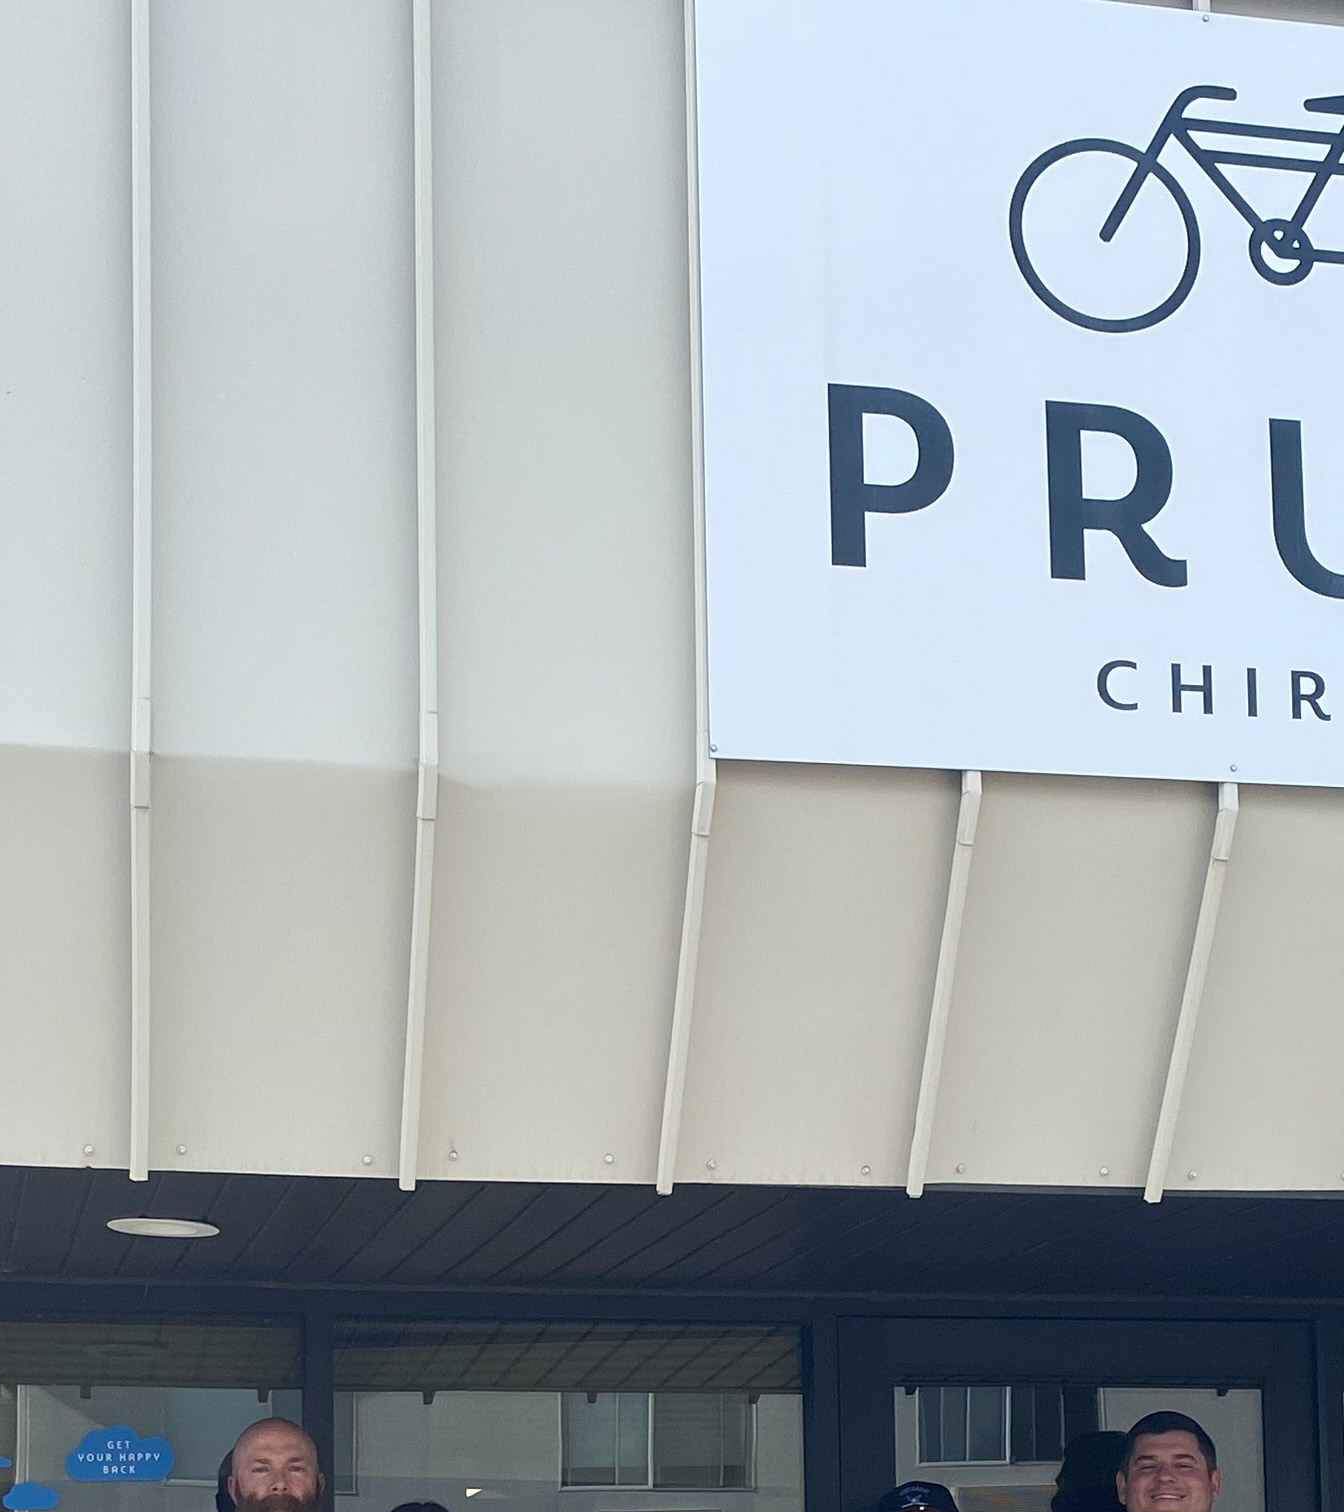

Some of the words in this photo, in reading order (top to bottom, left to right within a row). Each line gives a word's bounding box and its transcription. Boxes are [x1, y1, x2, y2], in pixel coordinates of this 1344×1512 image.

[107, 1440, 131, 1450] GET
[78, 1453, 113, 1463] YOUR
[119, 1452, 161, 1462] HAPPY
[103, 1465, 136, 1475] BACK
